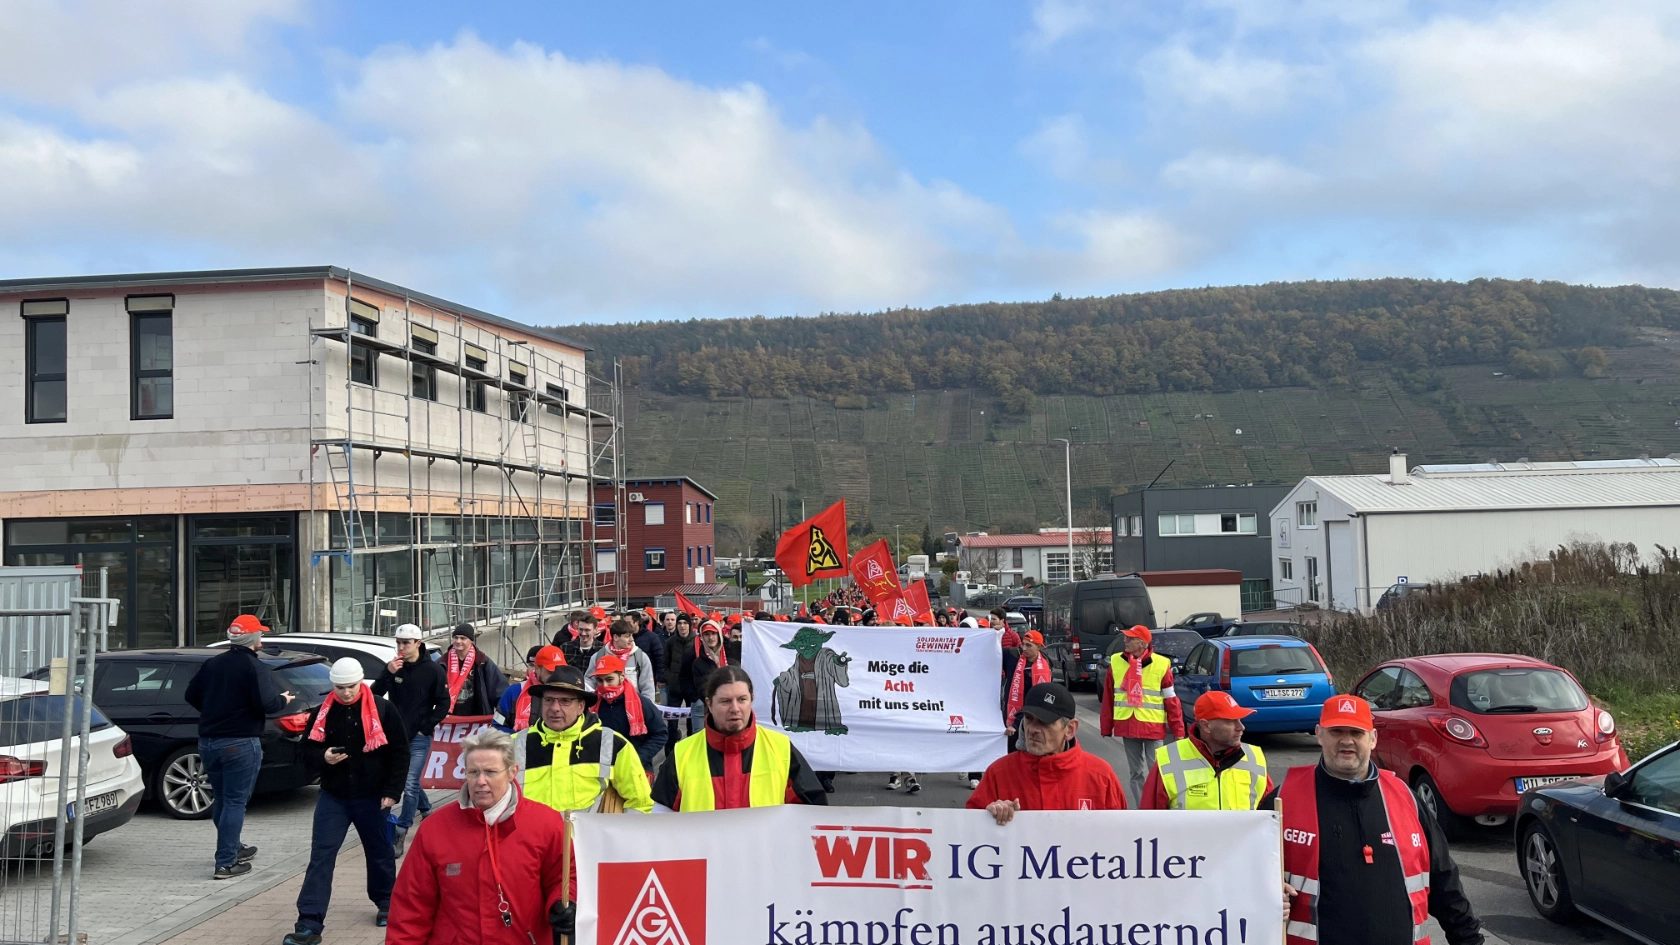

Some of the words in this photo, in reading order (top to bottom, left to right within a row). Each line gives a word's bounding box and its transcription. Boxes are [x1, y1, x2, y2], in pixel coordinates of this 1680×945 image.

[867, 660, 906, 676] Möge
[908, 661, 930, 674] die
[884, 679, 915, 693] Acht
[858, 696, 882, 709] mit
[884, 700, 910, 710] uns
[912, 699, 945, 711] sein!
[88, 797, 101, 811] FZ
[101, 793, 116, 807] 989
[1283, 828, 1317, 847] GEBT
[1411, 832, 1422, 848] 8!
[811, 835, 933, 881] WIR
[948, 843, 1004, 880] IG
[1018, 837, 1206, 880] Metaller
[765, 902, 960, 945] kämpfen
